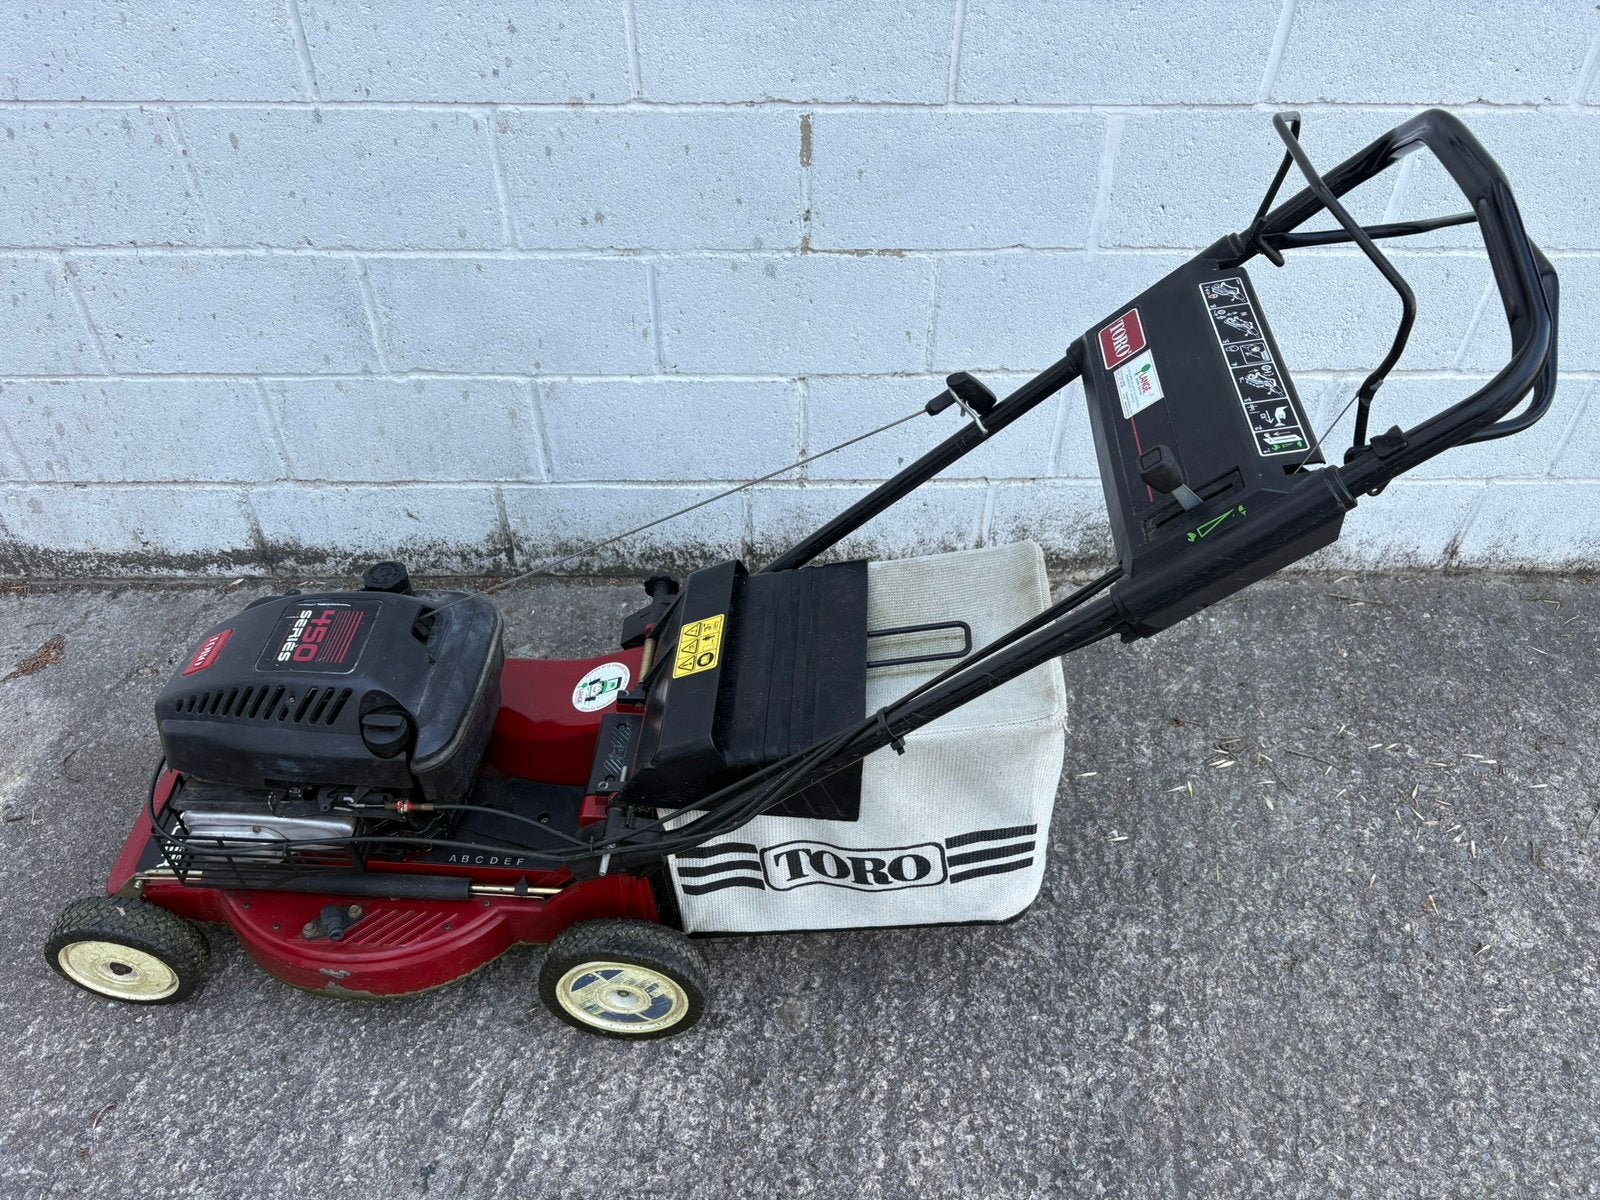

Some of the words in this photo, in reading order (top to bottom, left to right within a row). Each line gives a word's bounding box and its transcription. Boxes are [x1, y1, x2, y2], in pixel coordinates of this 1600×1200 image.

[1109, 318, 1131, 358] TORO
[1139, 372, 1151, 393] LANGE
[293, 608, 336, 662] 450
[774, 848, 931, 885] TORO
